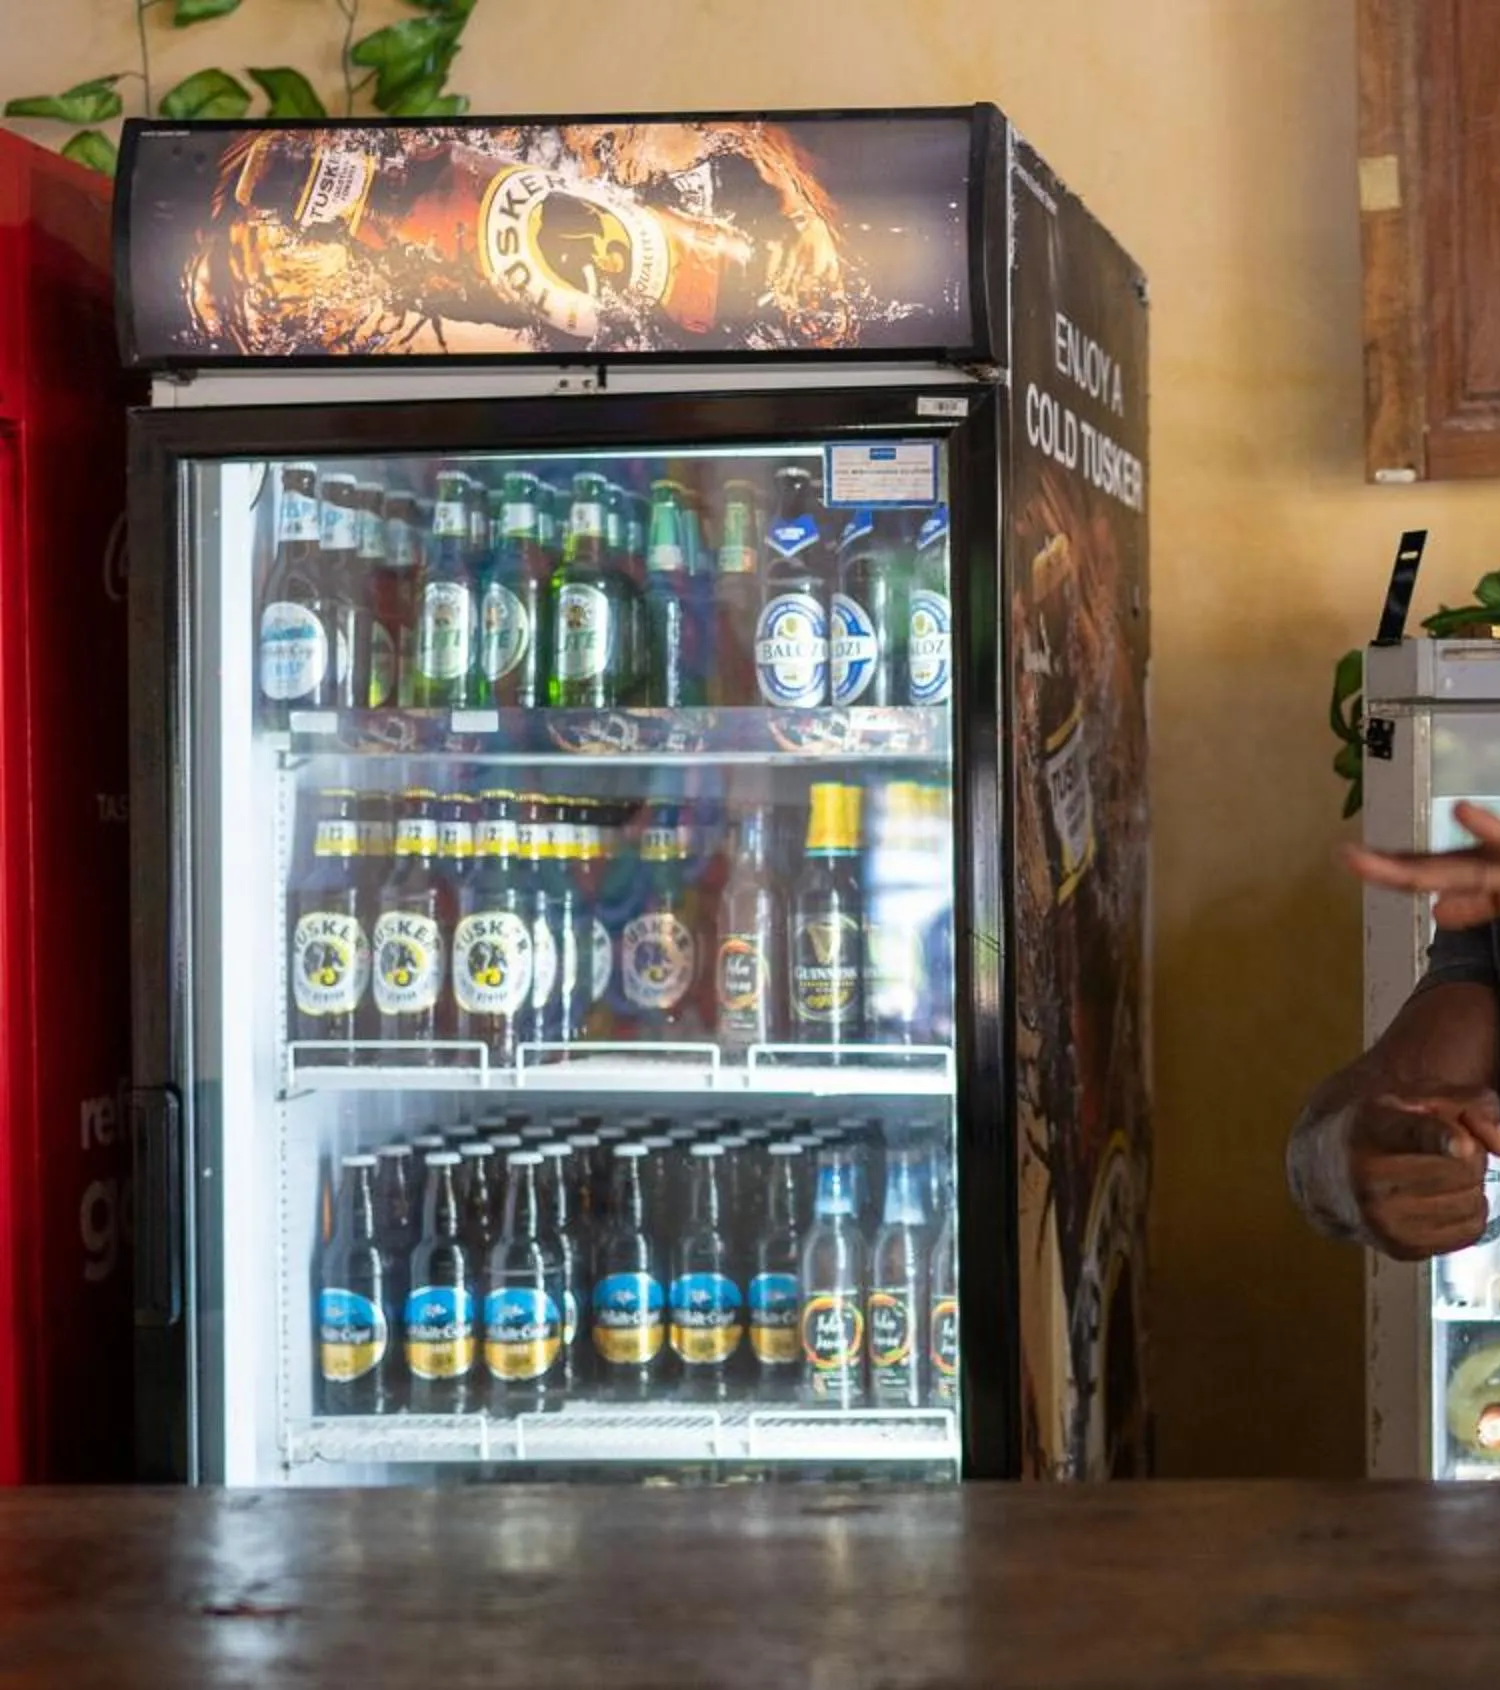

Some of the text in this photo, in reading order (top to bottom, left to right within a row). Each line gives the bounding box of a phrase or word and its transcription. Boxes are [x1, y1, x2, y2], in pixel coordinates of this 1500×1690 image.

[310, 152, 341, 218] TUSK
[496, 173, 567, 318] TUSKER
[1055, 312, 1124, 416] ENJOY A
[1026, 383, 1143, 512] COLD TUSKER
[834, 641, 862, 658] OZI
[456, 918, 529, 956] TUSKR
